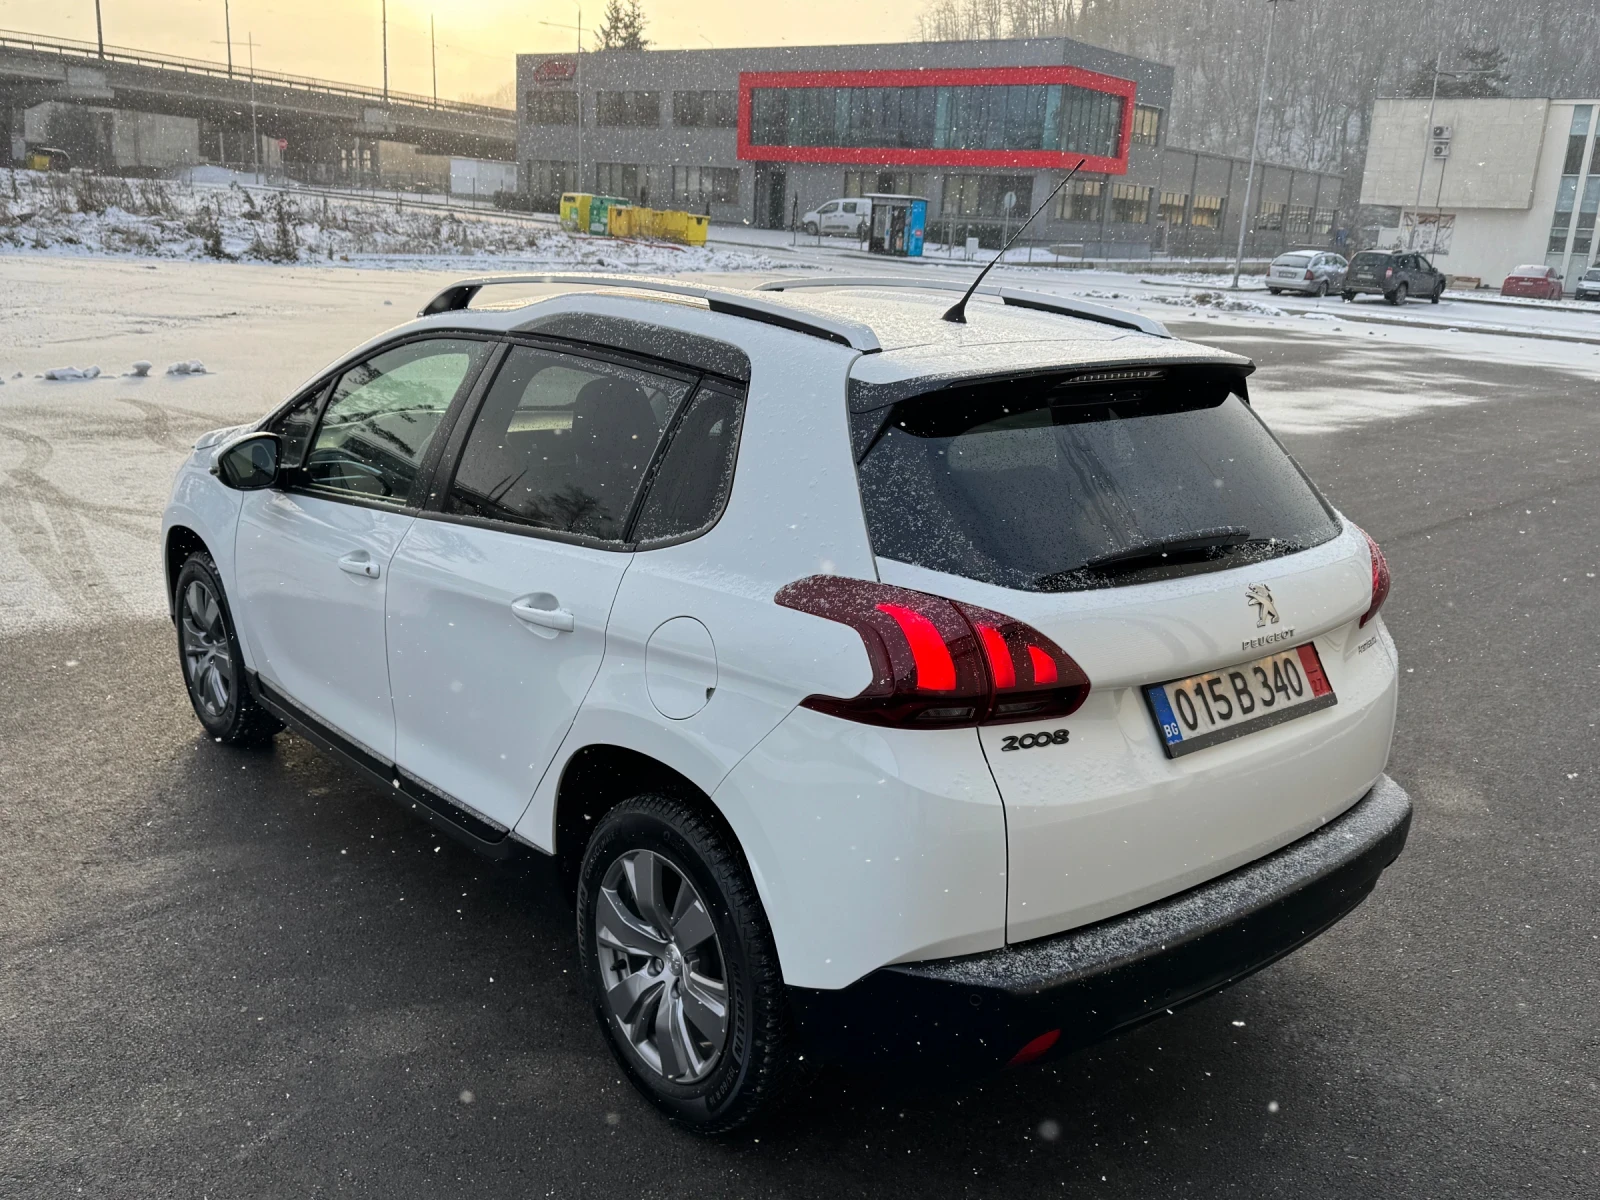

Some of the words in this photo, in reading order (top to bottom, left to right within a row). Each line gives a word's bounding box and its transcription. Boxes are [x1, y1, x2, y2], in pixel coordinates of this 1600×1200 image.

[1241, 628, 1296, 651] PEUGEOT
[1175, 678, 1233, 731] 015
[1229, 671, 1255, 716] B
[1253, 657, 1303, 707] 340
[1000, 728, 1070, 752] 2008
[1163, 722, 1179, 738] BG
[731, 961, 746, 1059] MICHELIN
